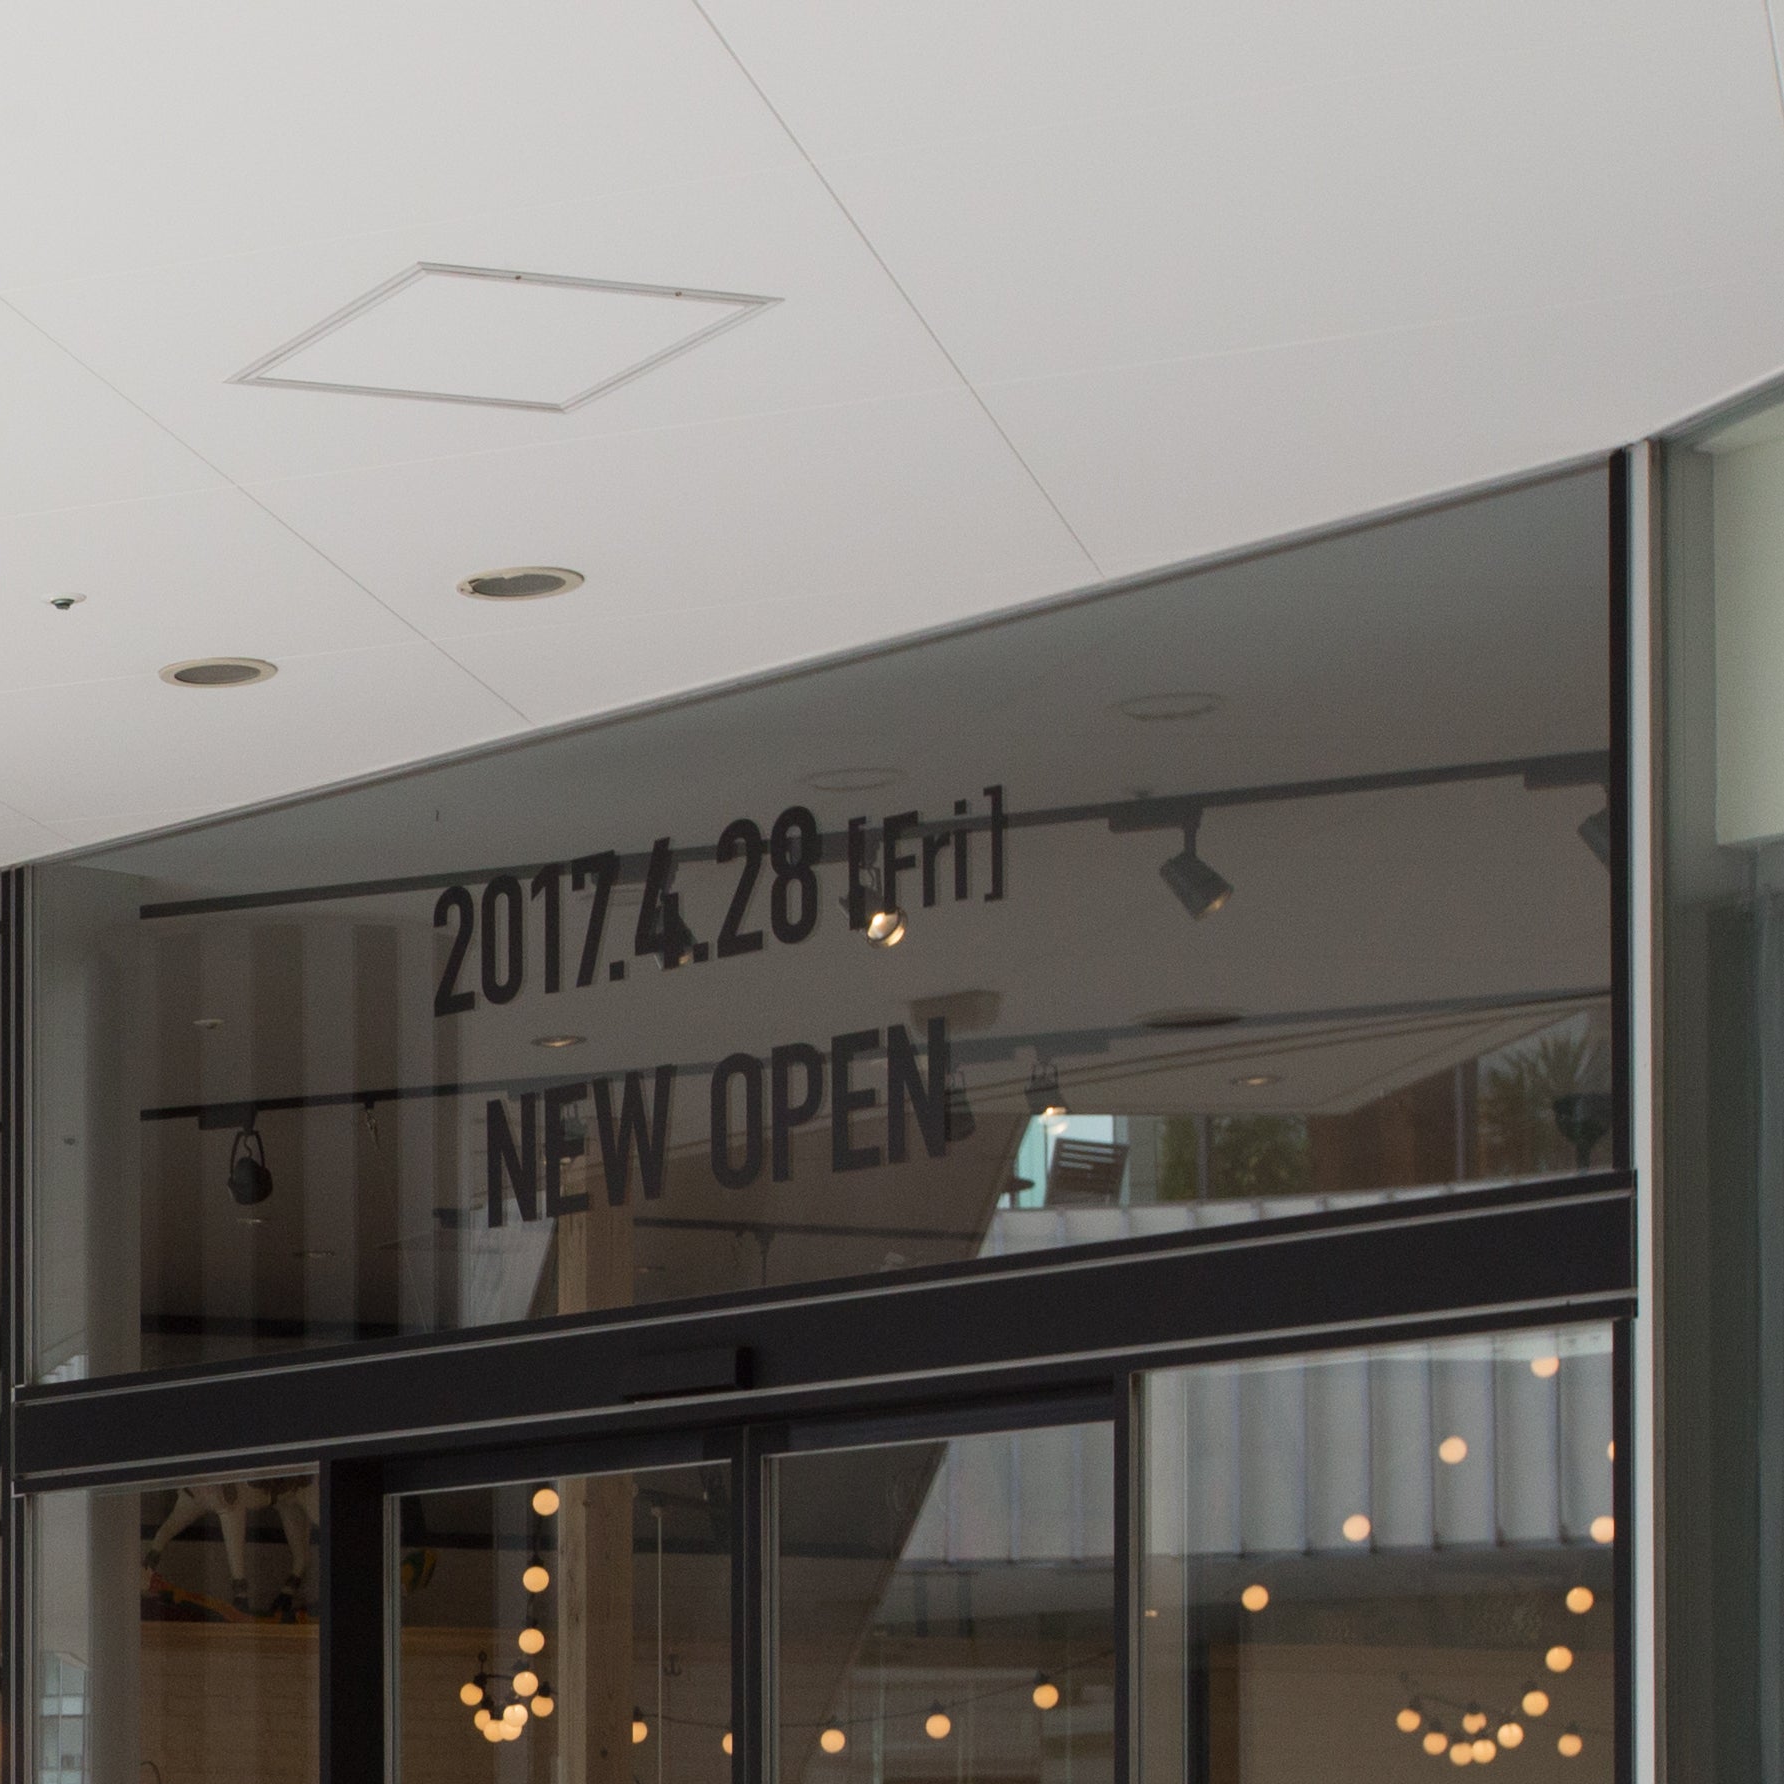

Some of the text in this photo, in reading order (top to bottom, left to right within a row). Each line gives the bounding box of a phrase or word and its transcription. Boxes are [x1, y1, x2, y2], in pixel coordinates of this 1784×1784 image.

[433, 785, 1005, 1017] 2017.4.28 [Fri]
[487, 1016, 947, 1228] NEW OPEN
